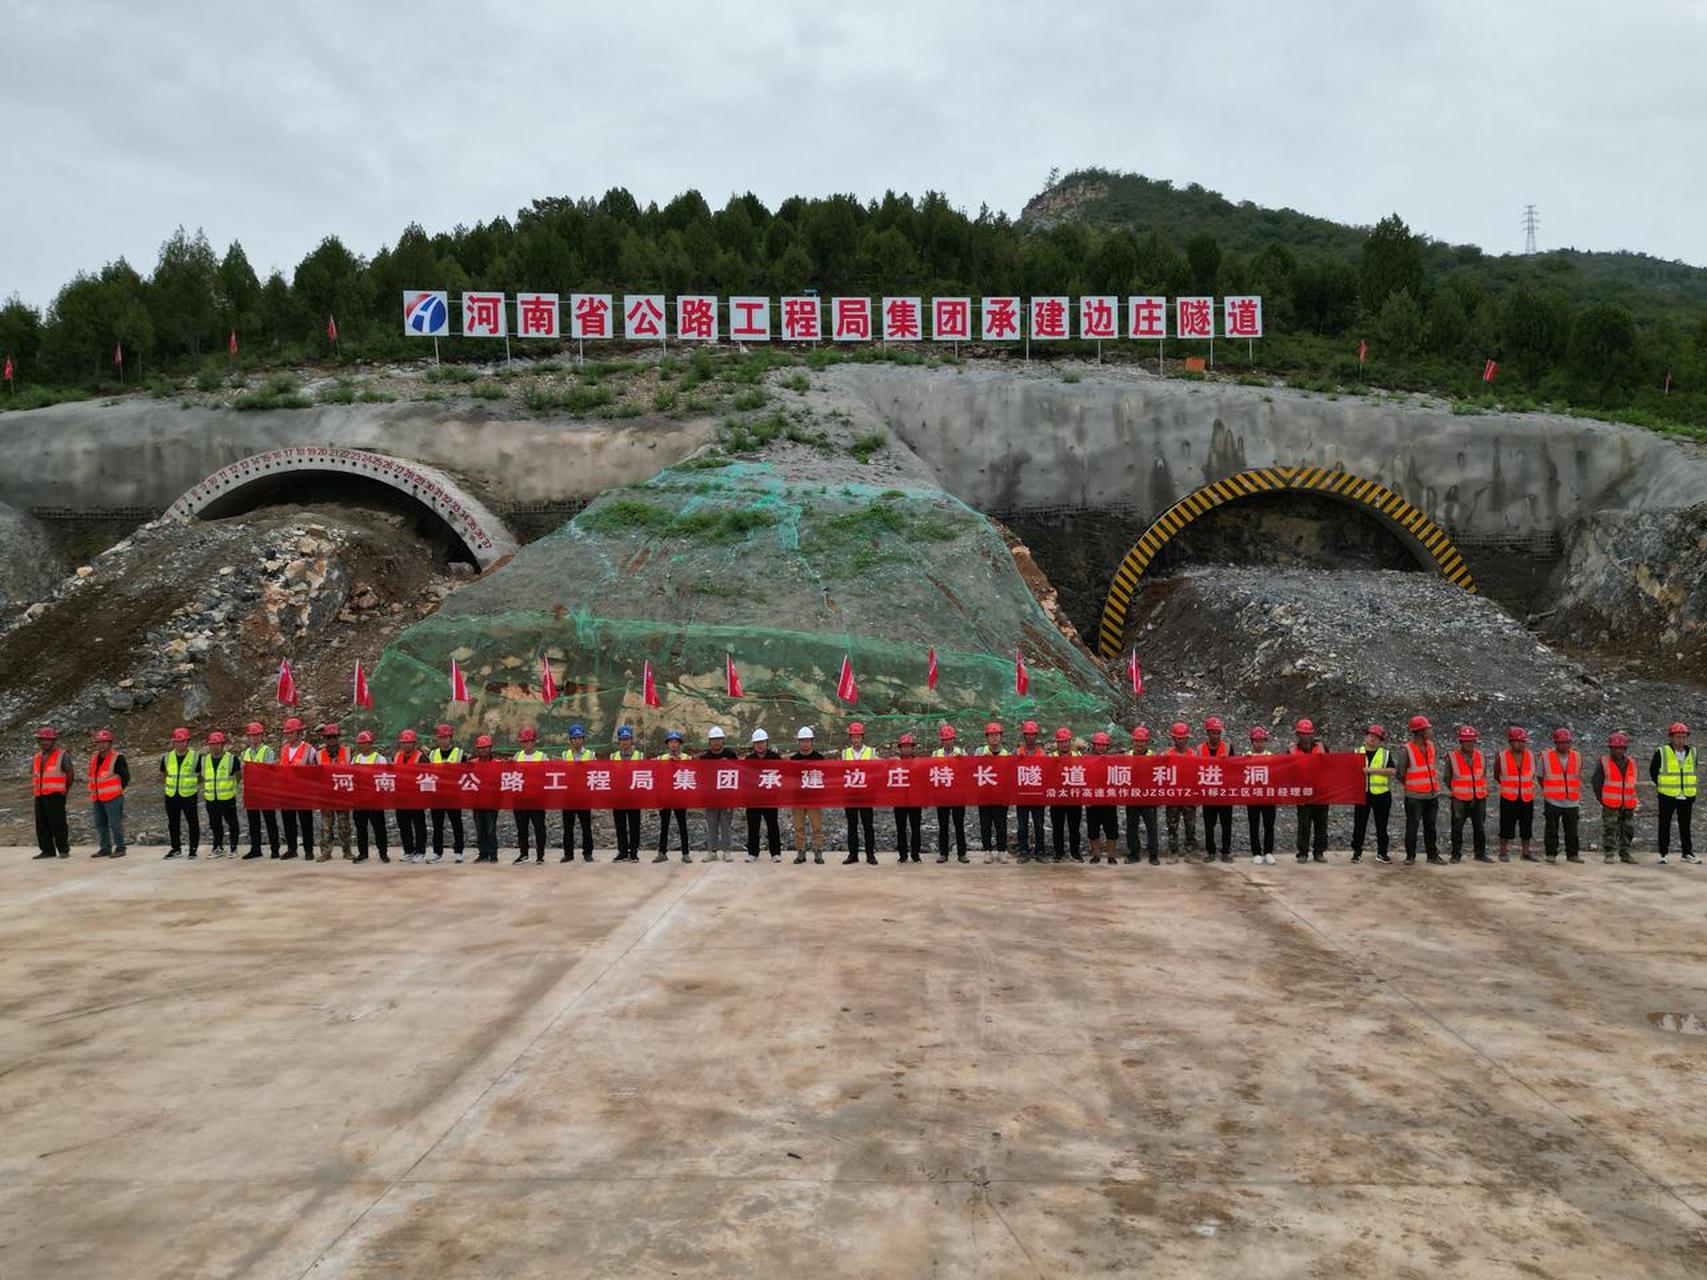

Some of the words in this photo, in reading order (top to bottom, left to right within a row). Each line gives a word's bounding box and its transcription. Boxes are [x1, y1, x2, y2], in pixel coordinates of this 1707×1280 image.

[466, 295, 1259, 338] 河南省公路工程局集团承建边庄隧道
[284, 448, 292, 456] 17
[317, 448, 328, 456] 20
[329, 448, 338, 456] 21
[340, 449, 350, 458] 22
[350, 452, 361, 460] 23
[362, 454, 372, 464] 24
[372, 456, 382, 466] 25
[383, 460, 393, 470] 26
[394, 464, 404, 474] 27
[404, 468, 414, 480] 28
[414, 474, 426, 486] 29
[424, 480, 435, 492] 30
[434, 488, 444, 498] 31
[442, 494, 452, 504] 32
[450, 502, 461, 512] 33
[468, 518, 478, 530] 35
[474, 528, 486, 540] 36
[482, 538, 492, 549] 37
[332, 764, 1270, 792] 河南省公路工程局集团承建边庄特长隧道顺利进洞
